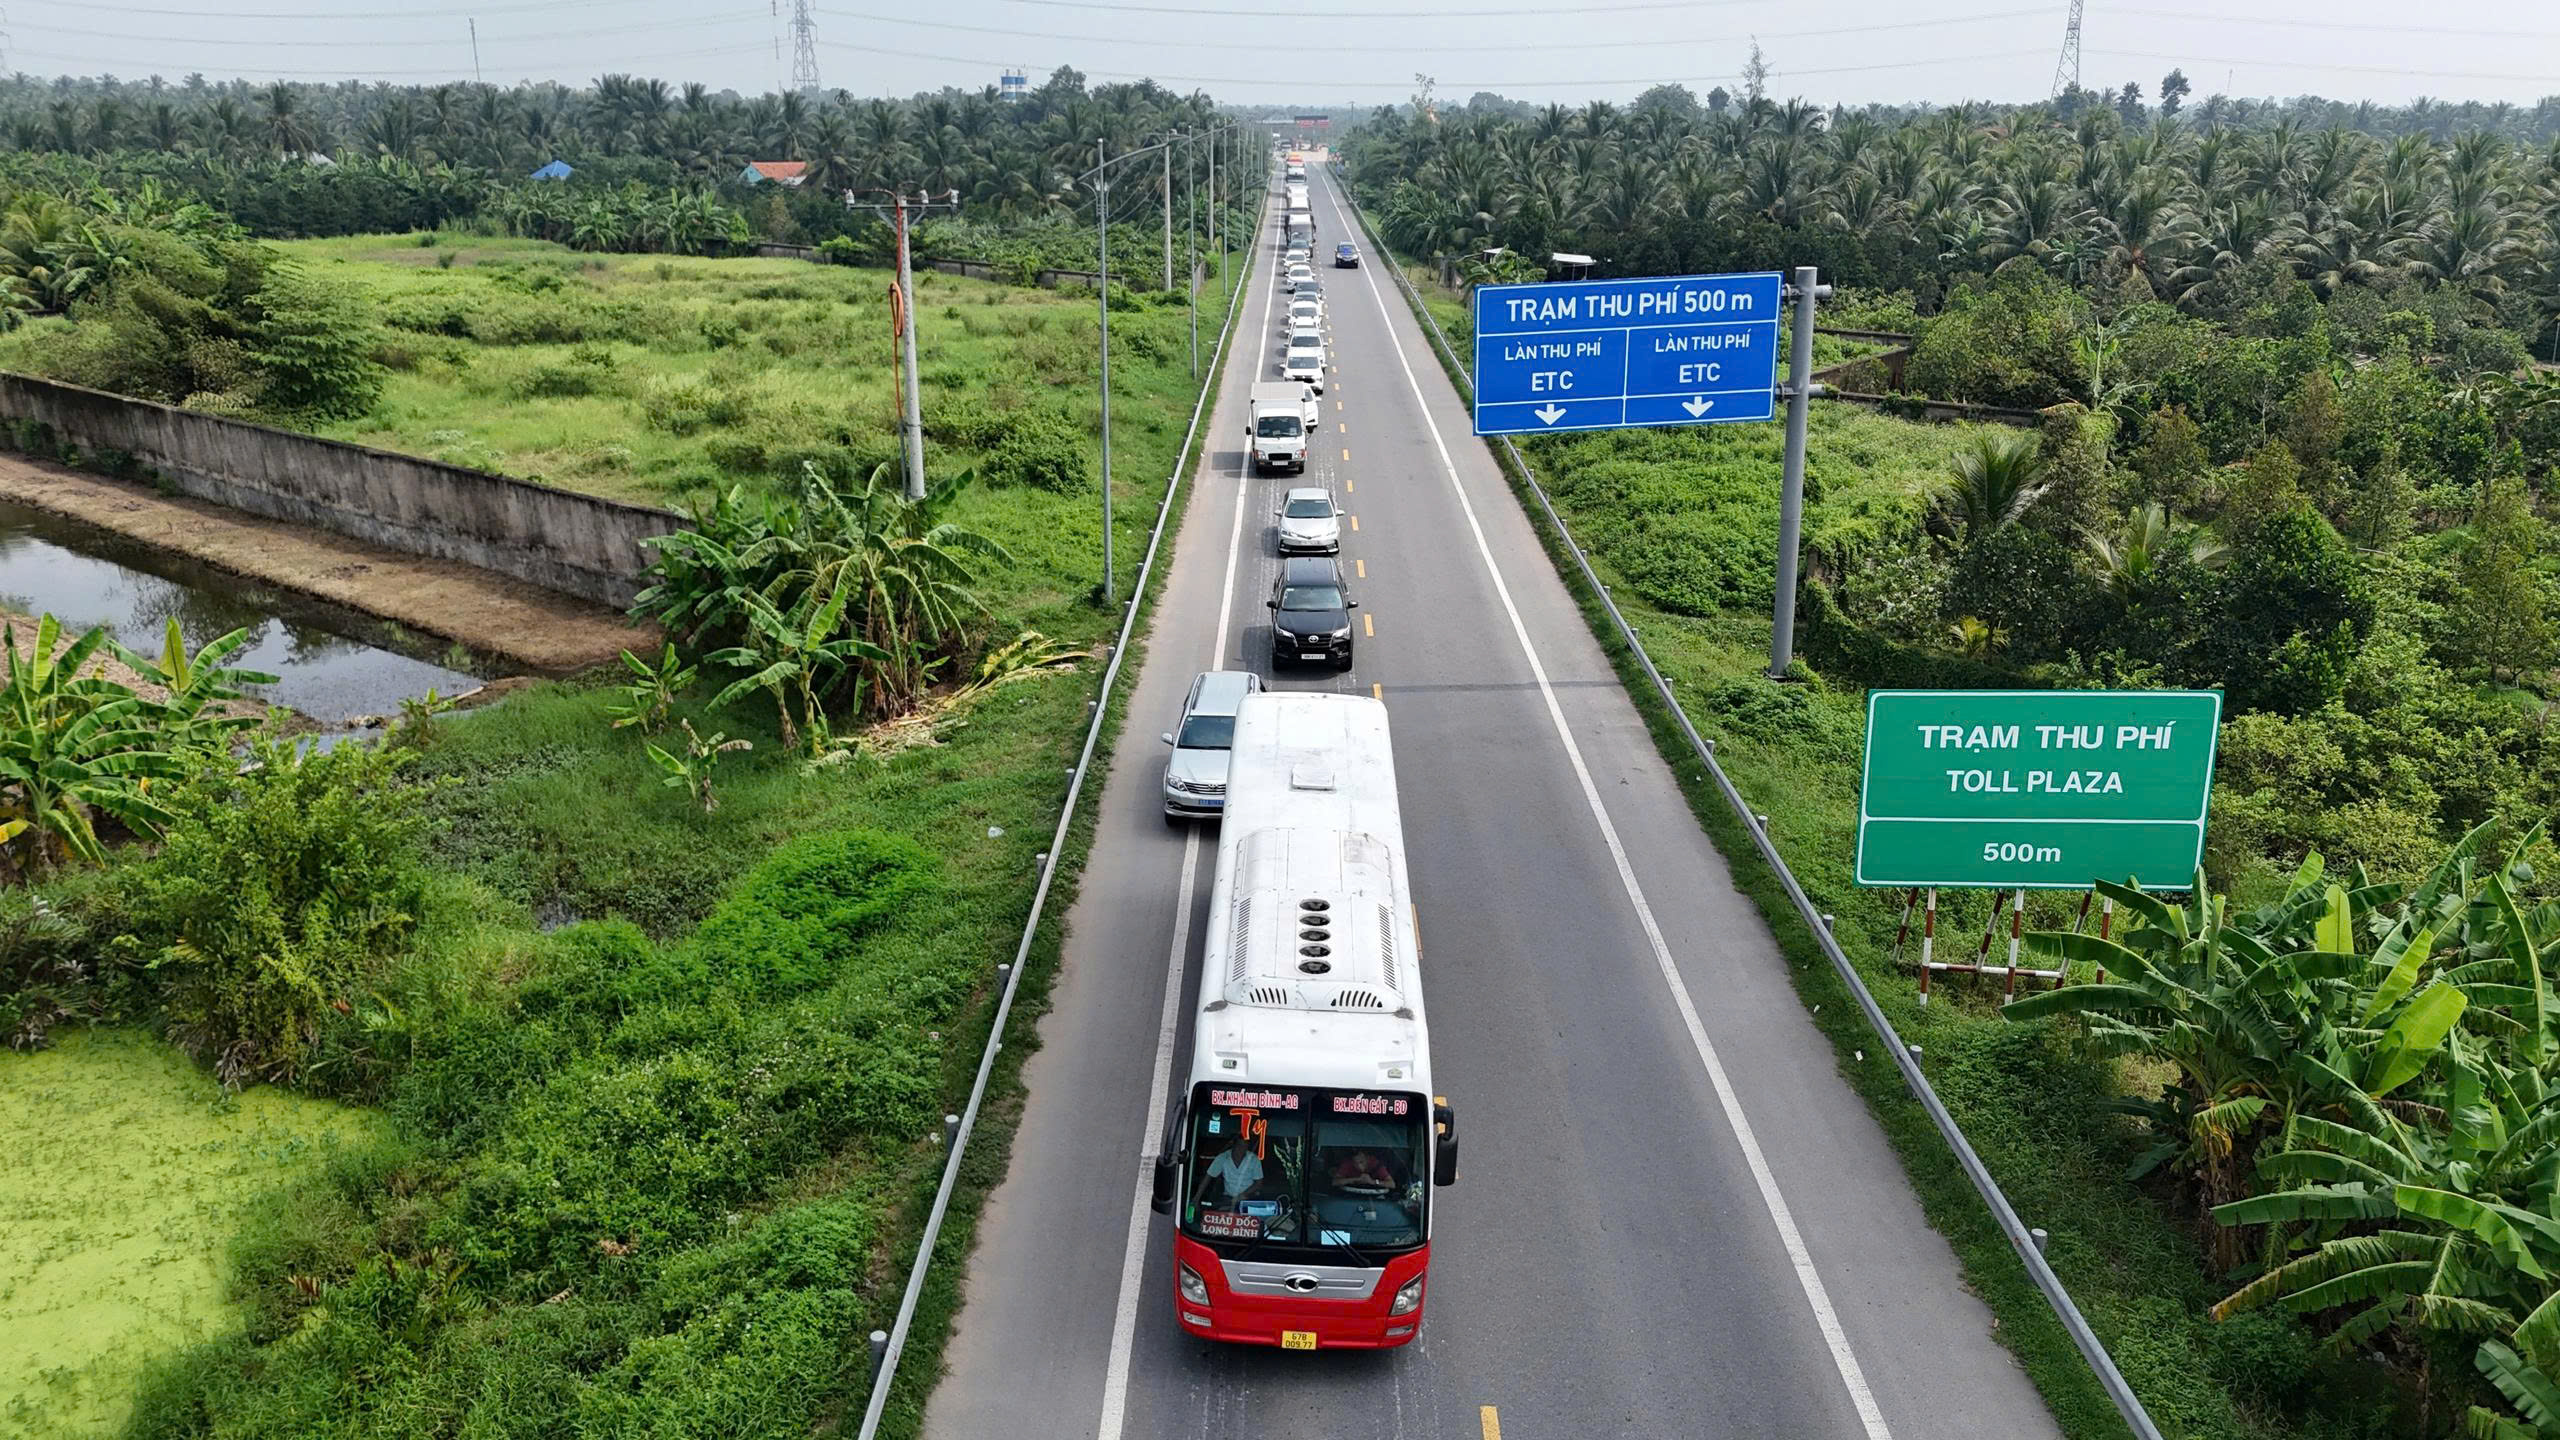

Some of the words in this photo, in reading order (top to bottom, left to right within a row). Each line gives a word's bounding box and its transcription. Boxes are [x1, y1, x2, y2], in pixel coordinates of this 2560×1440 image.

[1506, 296, 1576, 325] TRẠM
[1584, 294, 1632, 317] THU
[1639, 285, 1681, 315] PHÍ
[1684, 289, 1725, 312] 500
[1731, 292, 1753, 311] m
[1504, 341, 1537, 361] LÀN
[1540, 343, 1571, 359] THU
[1577, 337, 1602, 357] PHÍ
[1655, 333, 1688, 353] LÀN
[1691, 335, 1722, 351] THU
[1725, 329, 1752, 349] PHÍ
[1531, 371, 1574, 392] ETC
[1679, 363, 1721, 384] ETC
[1917, 725, 2020, 753] TRẠM
[2035, 725, 2104, 749] THU
[2116, 720, 2177, 749] PHÍ
[1946, 769, 2019, 793] TOLL
[2026, 770, 2124, 794] PLAZA
[1983, 842, 2061, 862] 500m
[1369, 1095, 1388, 1114] CÁT
[1203, 1214, 1233, 1226] CHÂU
[1202, 1224, 1230, 1236] LONG
[1232, 1226, 1259, 1238] BÌNH
